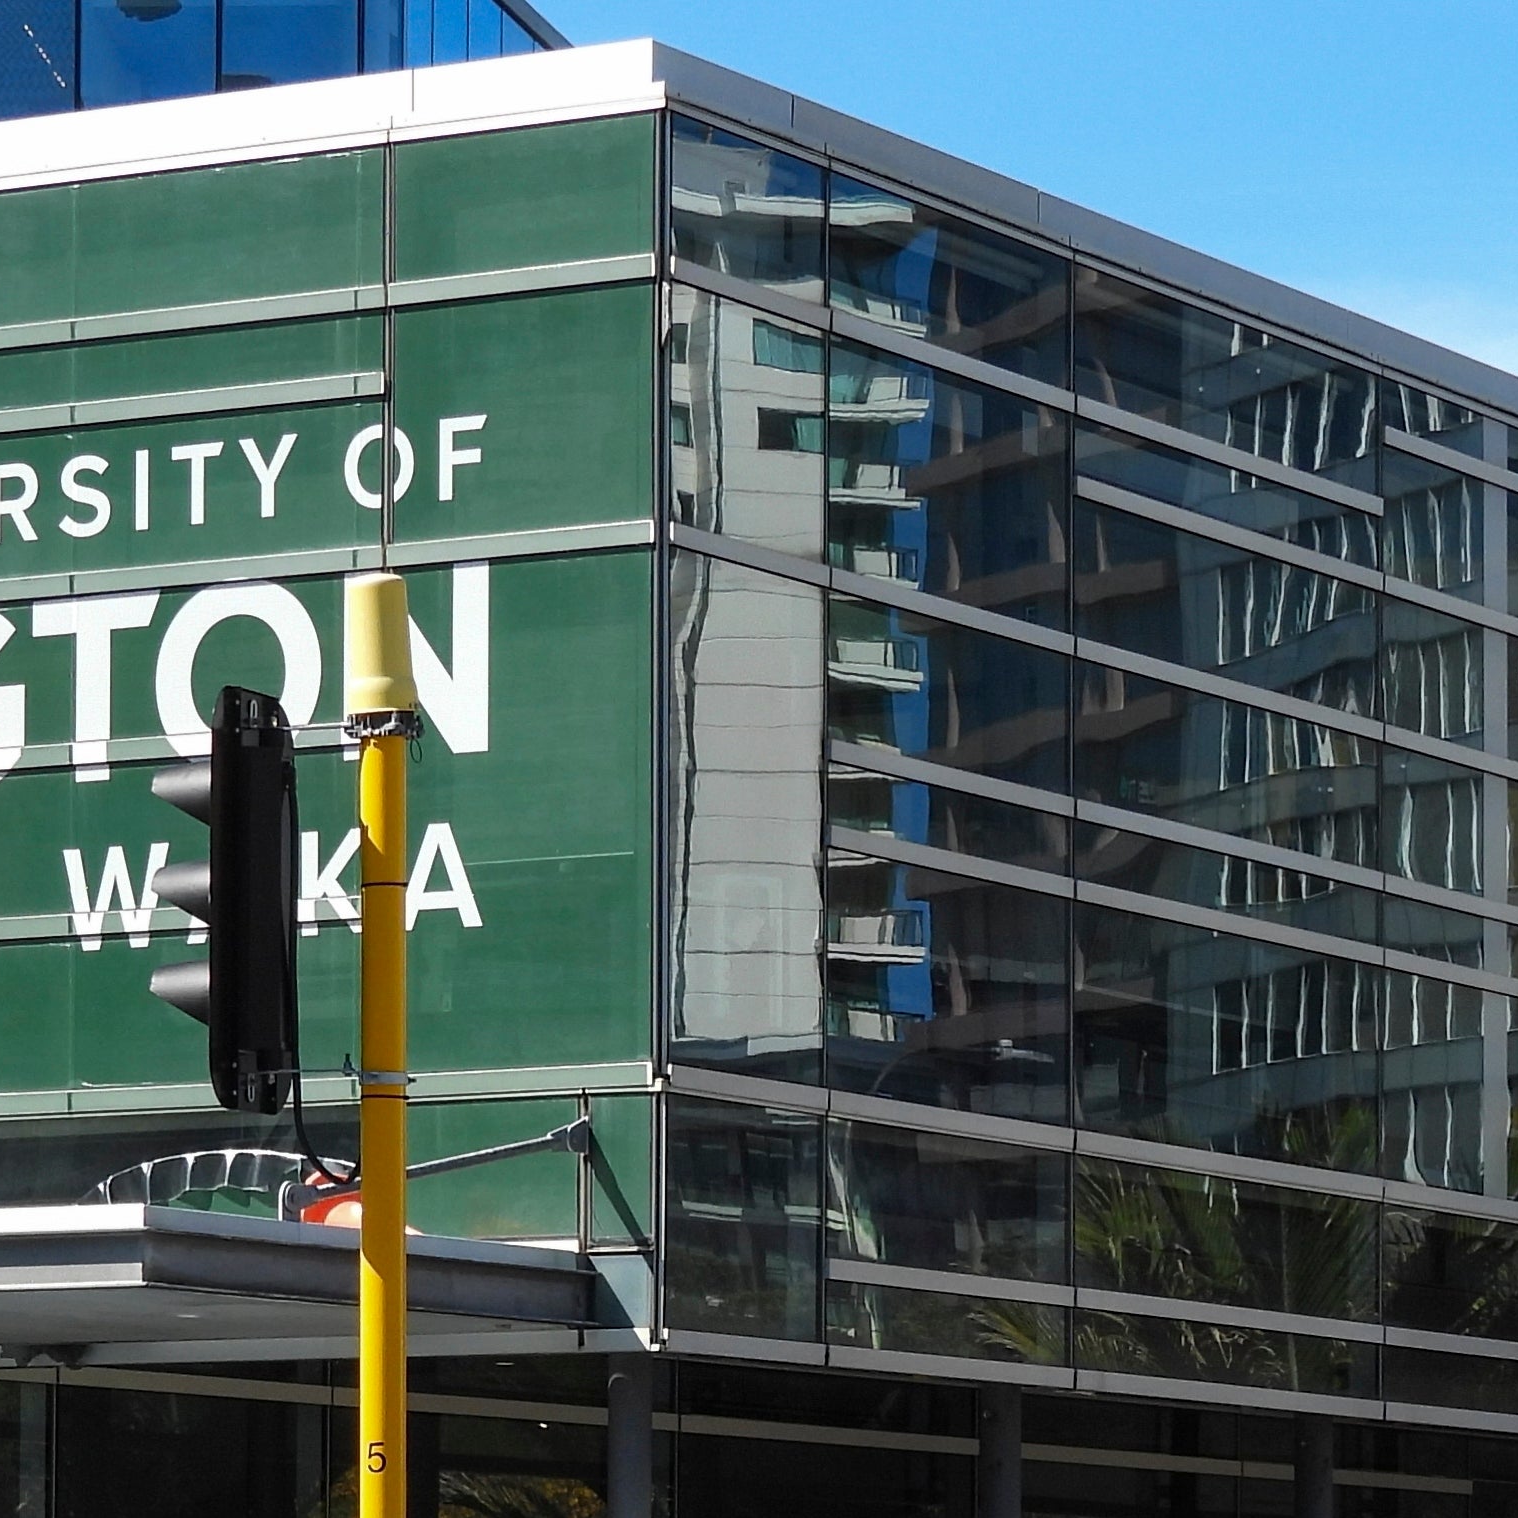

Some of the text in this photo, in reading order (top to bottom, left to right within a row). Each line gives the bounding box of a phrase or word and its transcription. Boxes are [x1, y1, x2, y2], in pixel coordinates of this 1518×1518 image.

[343, 414, 488, 510] OF
[62, 822, 483, 952] WKA
[367, 1441, 387, 1474] 5
